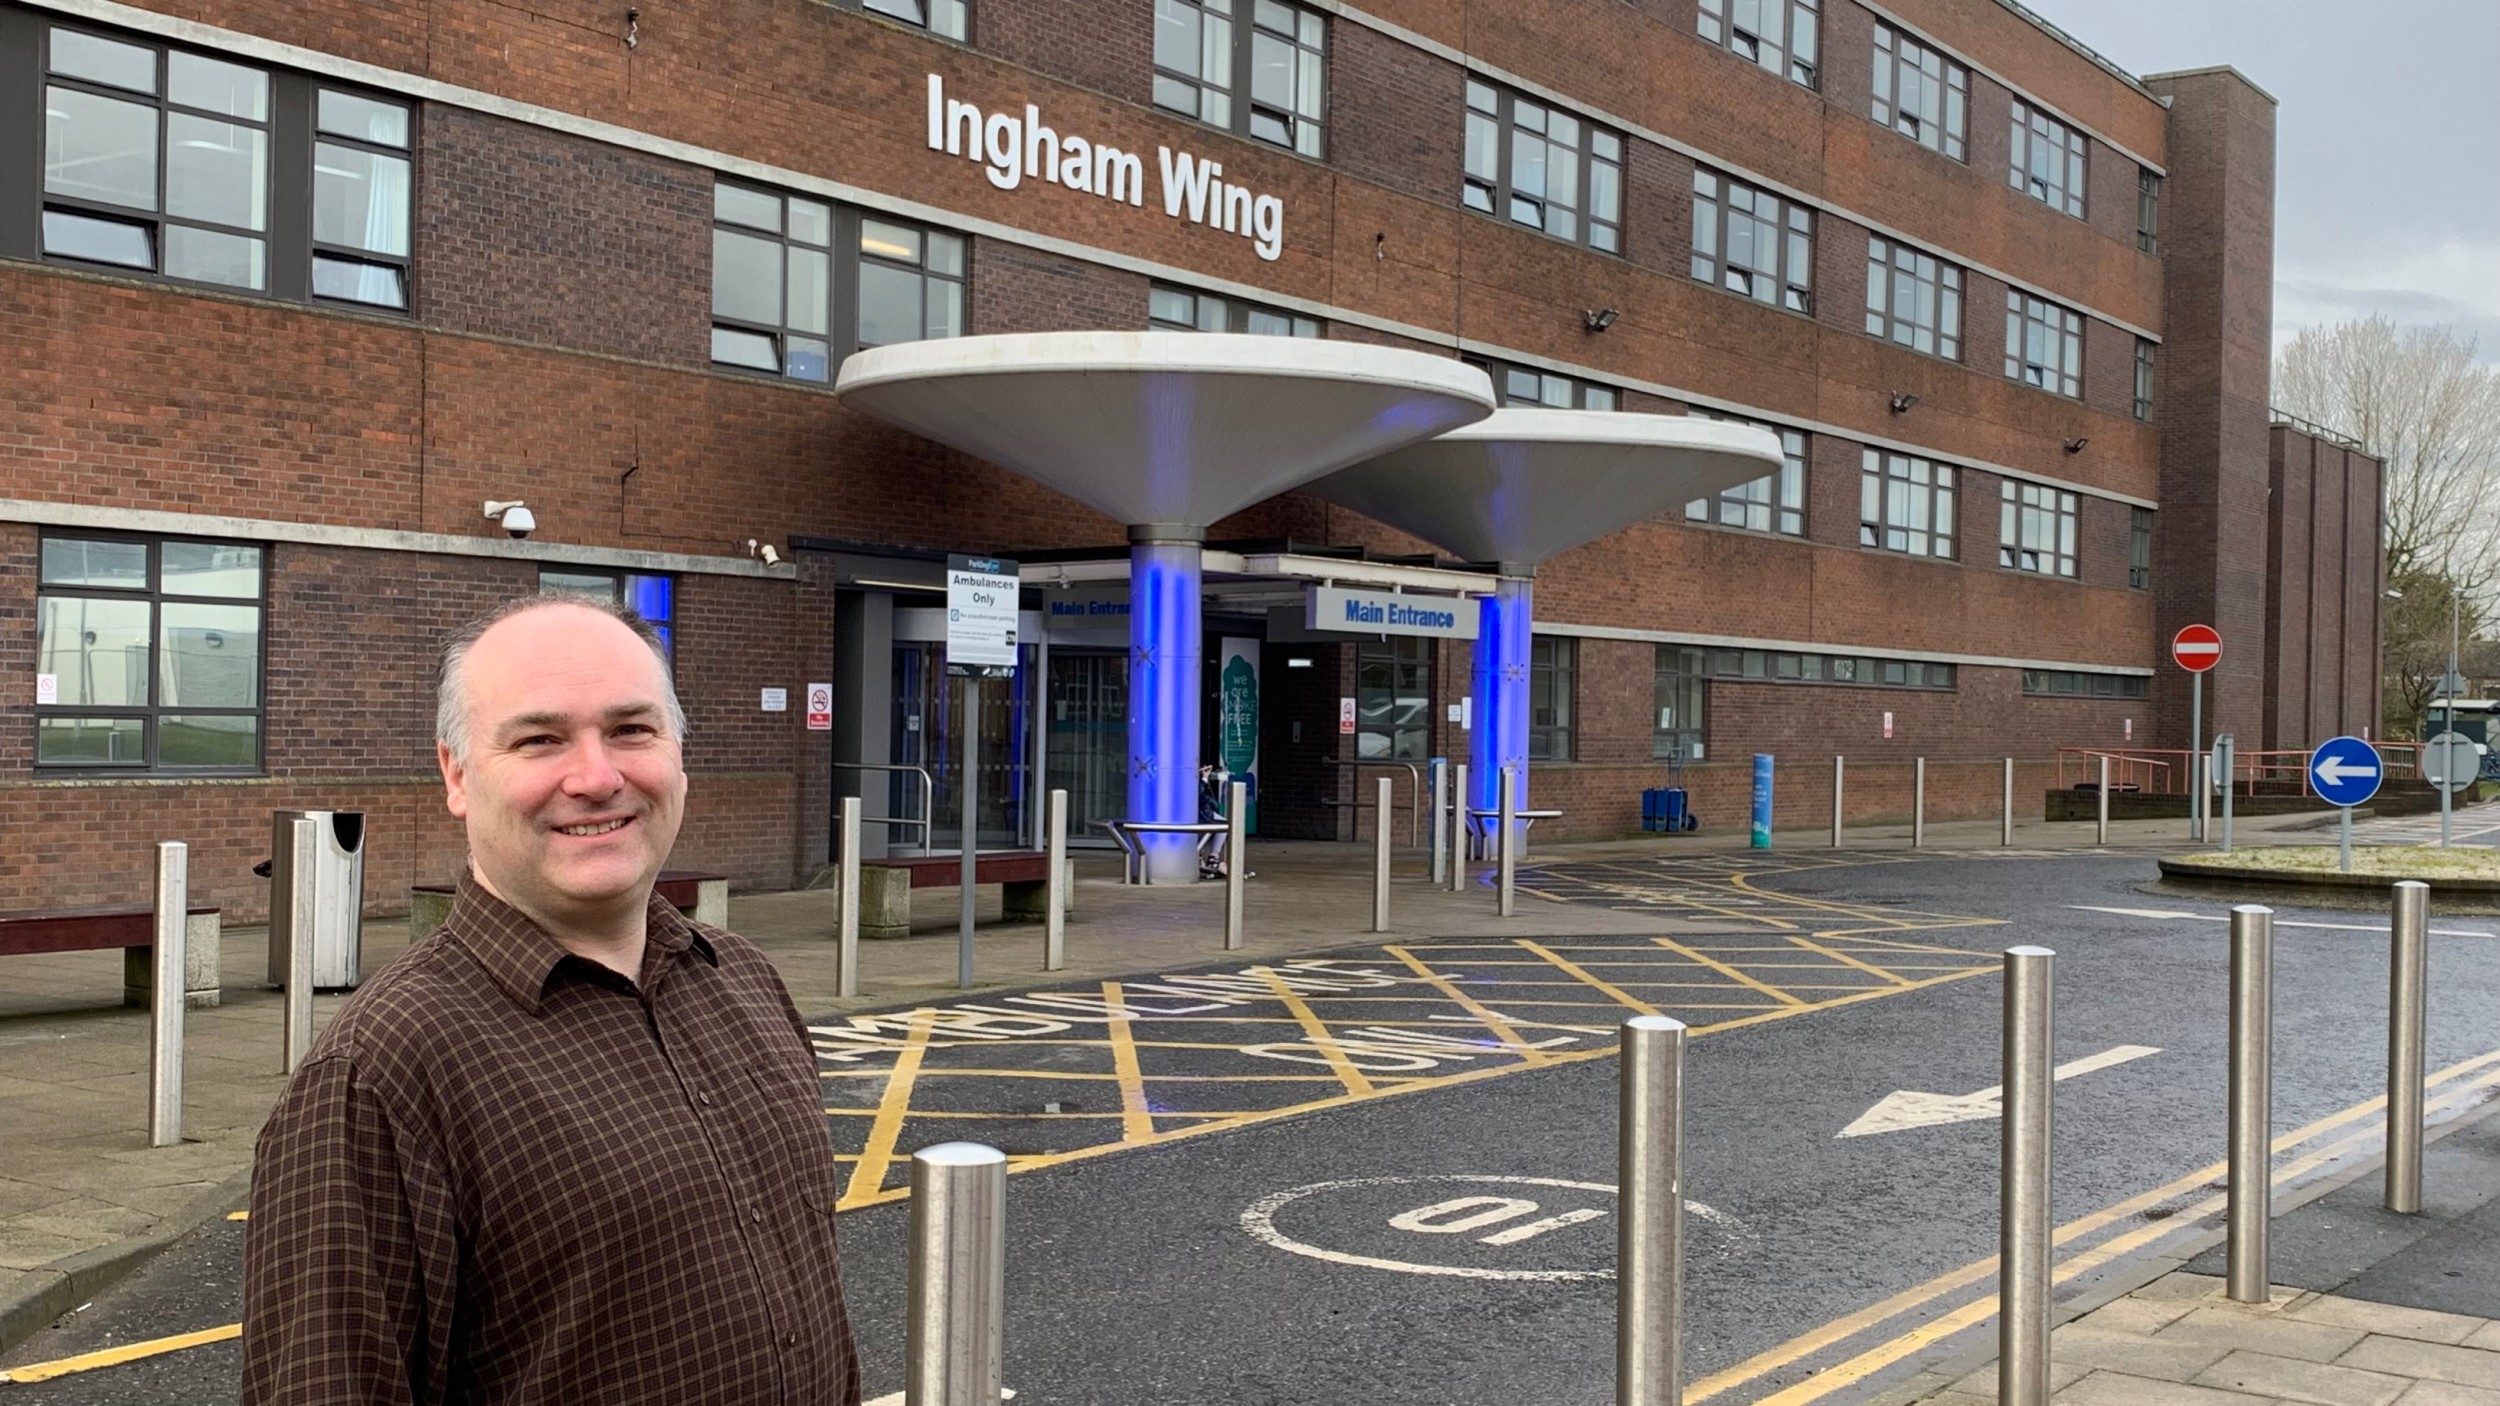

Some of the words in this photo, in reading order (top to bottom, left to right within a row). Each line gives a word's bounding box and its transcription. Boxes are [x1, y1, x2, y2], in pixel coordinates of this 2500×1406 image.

[928, 73, 1143, 207] Ingham
[1158, 145, 1283, 261] Wing
[953, 574, 1014, 590] Ambulances
[973, 592, 995, 607] Only
[1052, 602, 1085, 615] Main
[1088, 601, 1131, 615] Entran
[1345, 599, 1384, 623] Main
[1388, 602, 1455, 628] Entrance
[1233, 675, 1248, 685] we
[1231, 687, 1249, 698] are
[1239, 1010, 1615, 1071] ONLY
